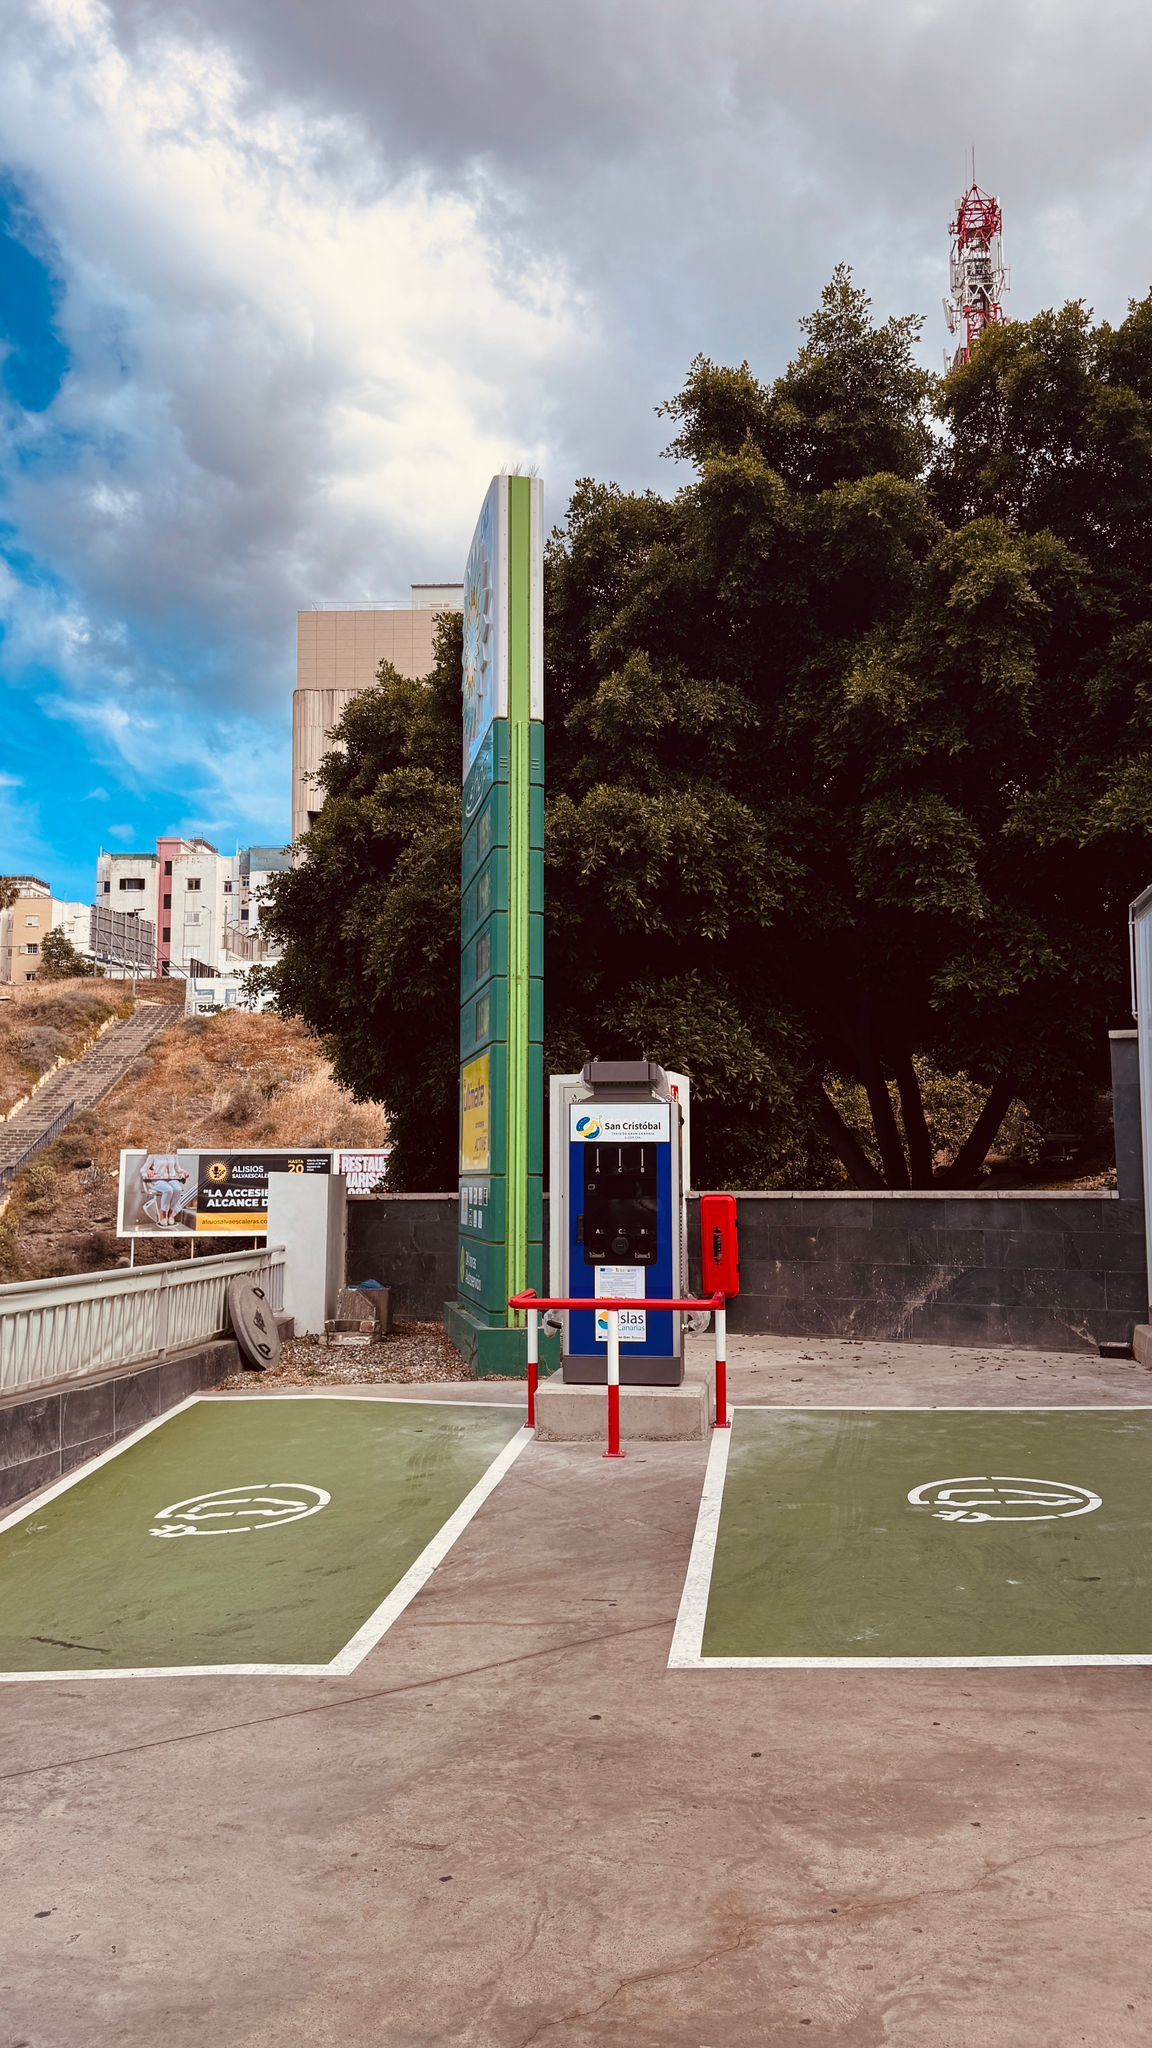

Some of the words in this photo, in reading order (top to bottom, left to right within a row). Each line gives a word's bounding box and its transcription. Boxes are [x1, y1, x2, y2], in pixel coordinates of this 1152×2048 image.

[605, 1122, 620, 1130] San
[623, 1121, 661, 1130] Cristóbal
[232, 1165, 264, 1173] ALISIOS
[288, 1164, 304, 1173] 20
[207, 1199, 259, 1207] ALCANCE
